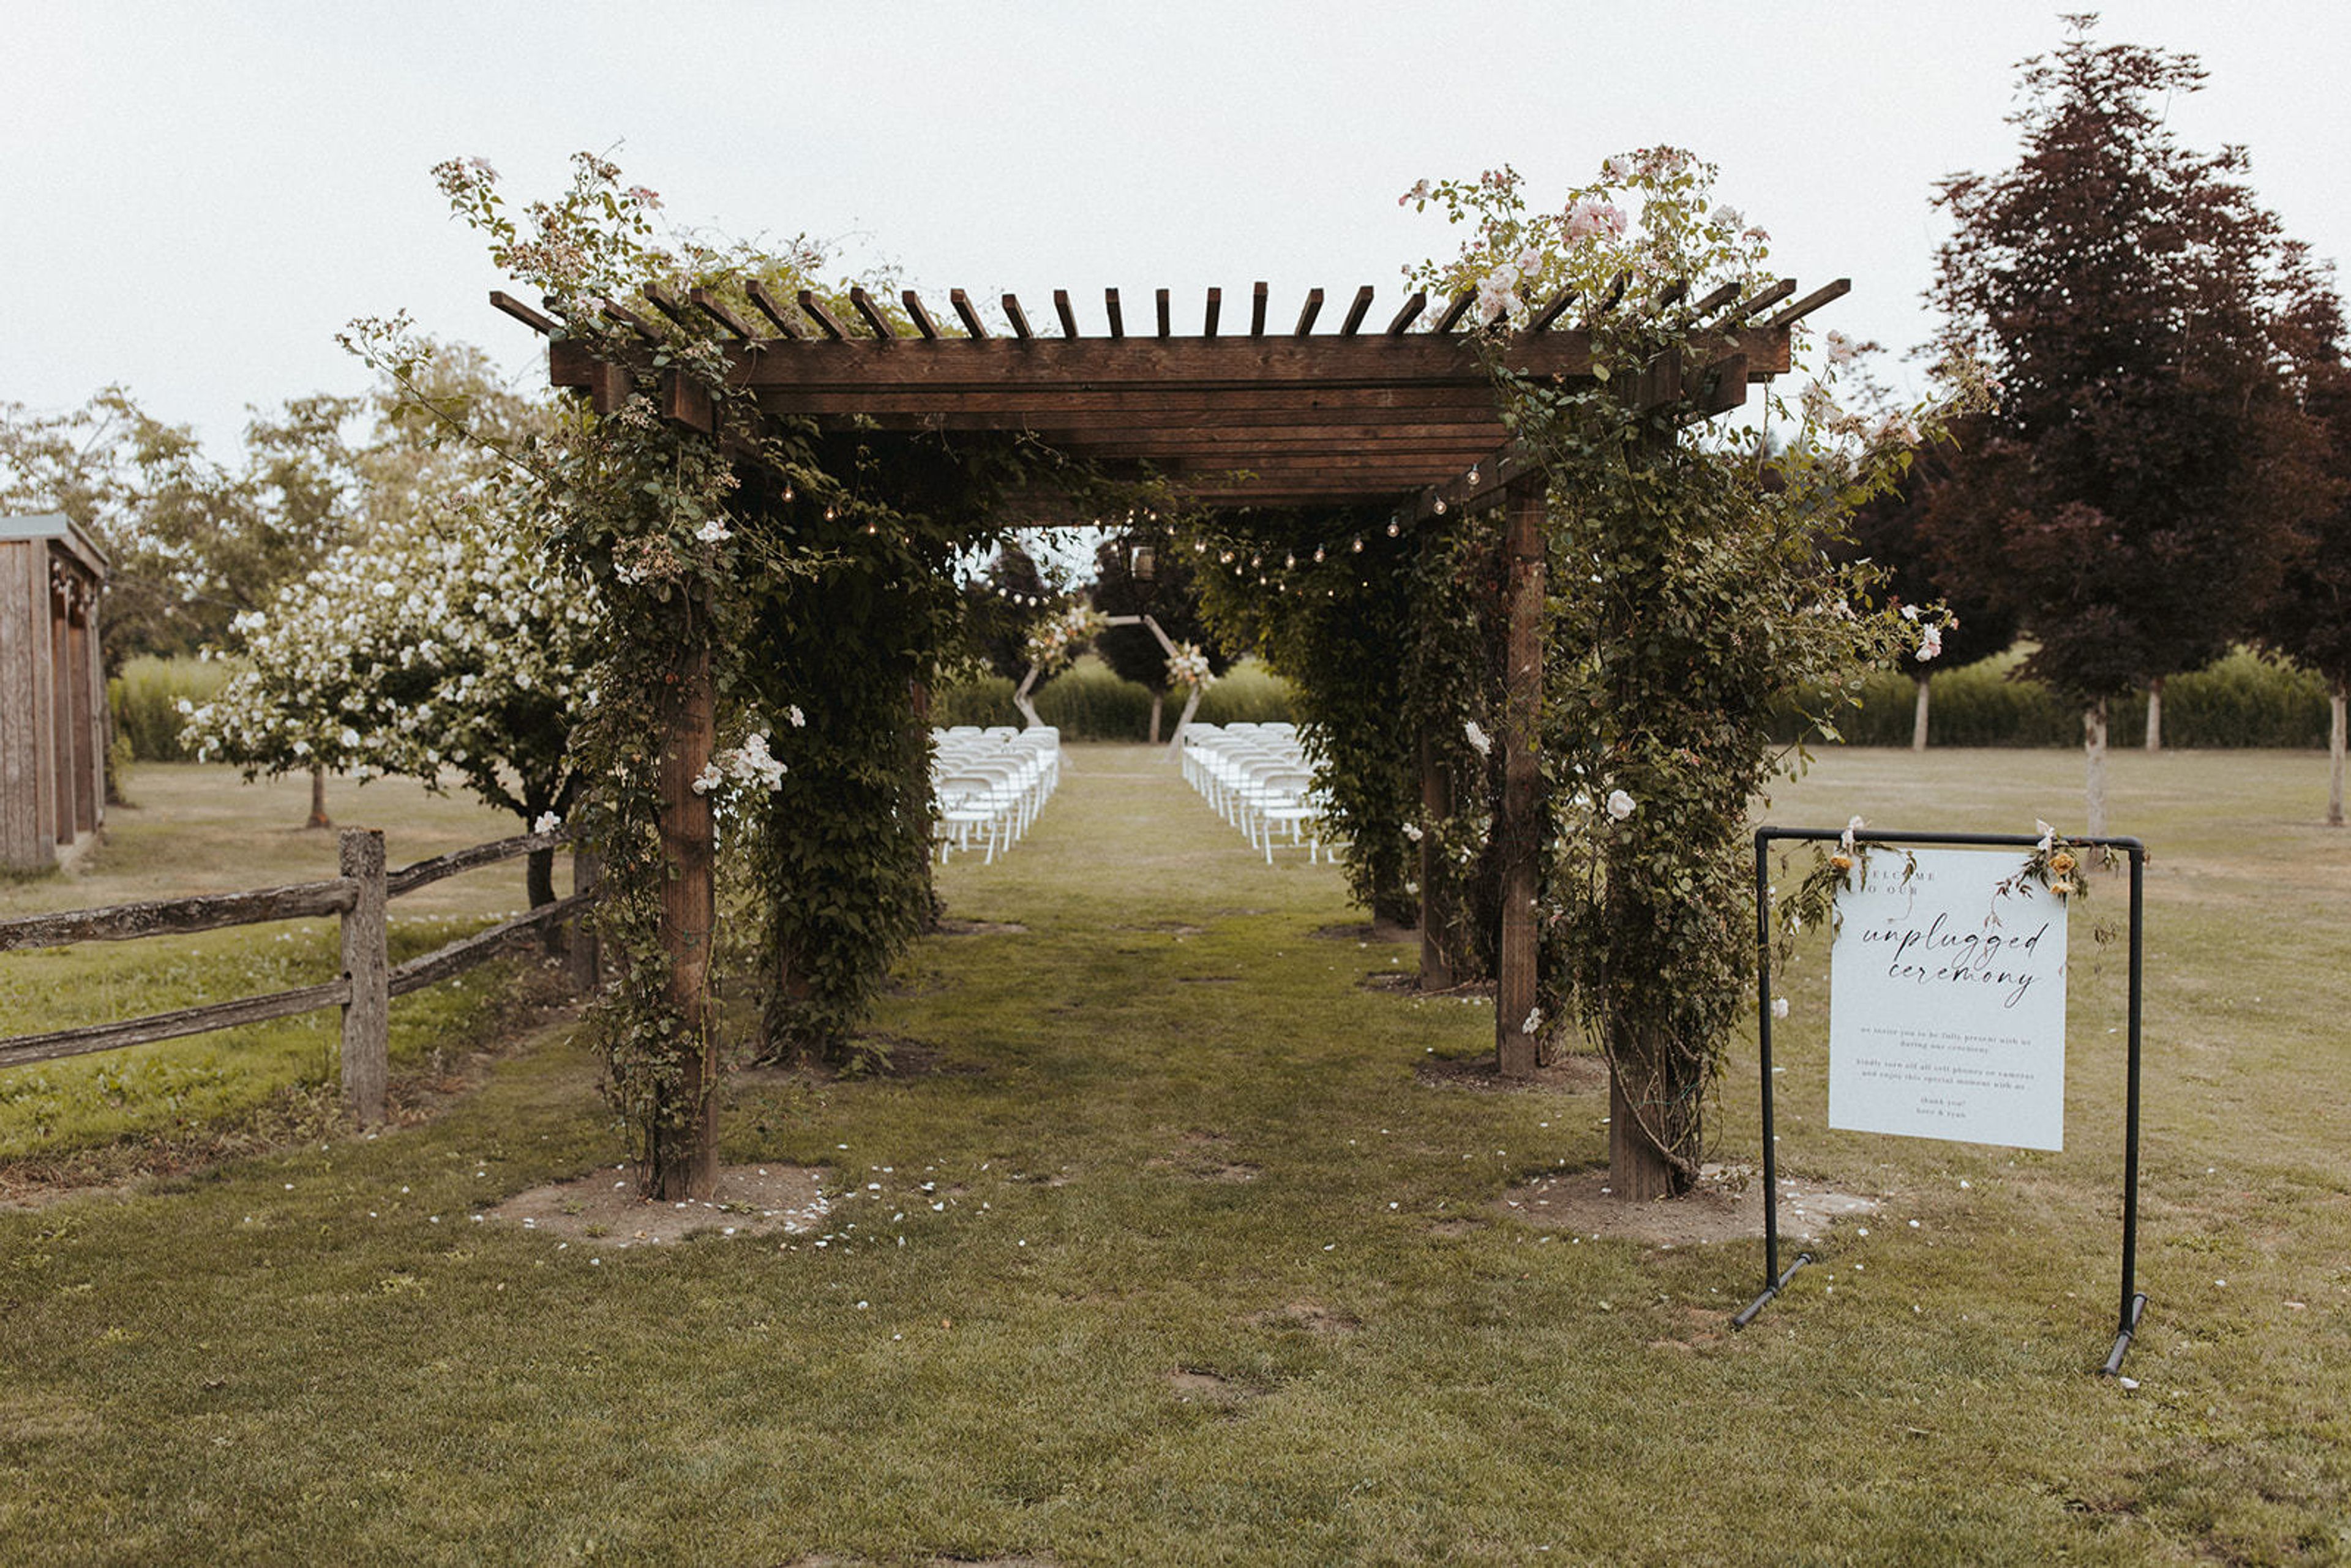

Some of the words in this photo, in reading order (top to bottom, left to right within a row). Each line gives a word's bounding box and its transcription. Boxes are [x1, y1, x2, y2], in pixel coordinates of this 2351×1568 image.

[1887, 886, 1917, 895] OUR
[1863, 912, 2050, 972] unplugged
[1889, 964, 2042, 1009] ceremony
[1941, 1032, 1961, 1041] fully
[1964, 1034, 1997, 1043] present
[1900, 1040, 1927, 1050] during
[1856, 1058, 1881, 1068] kindly
